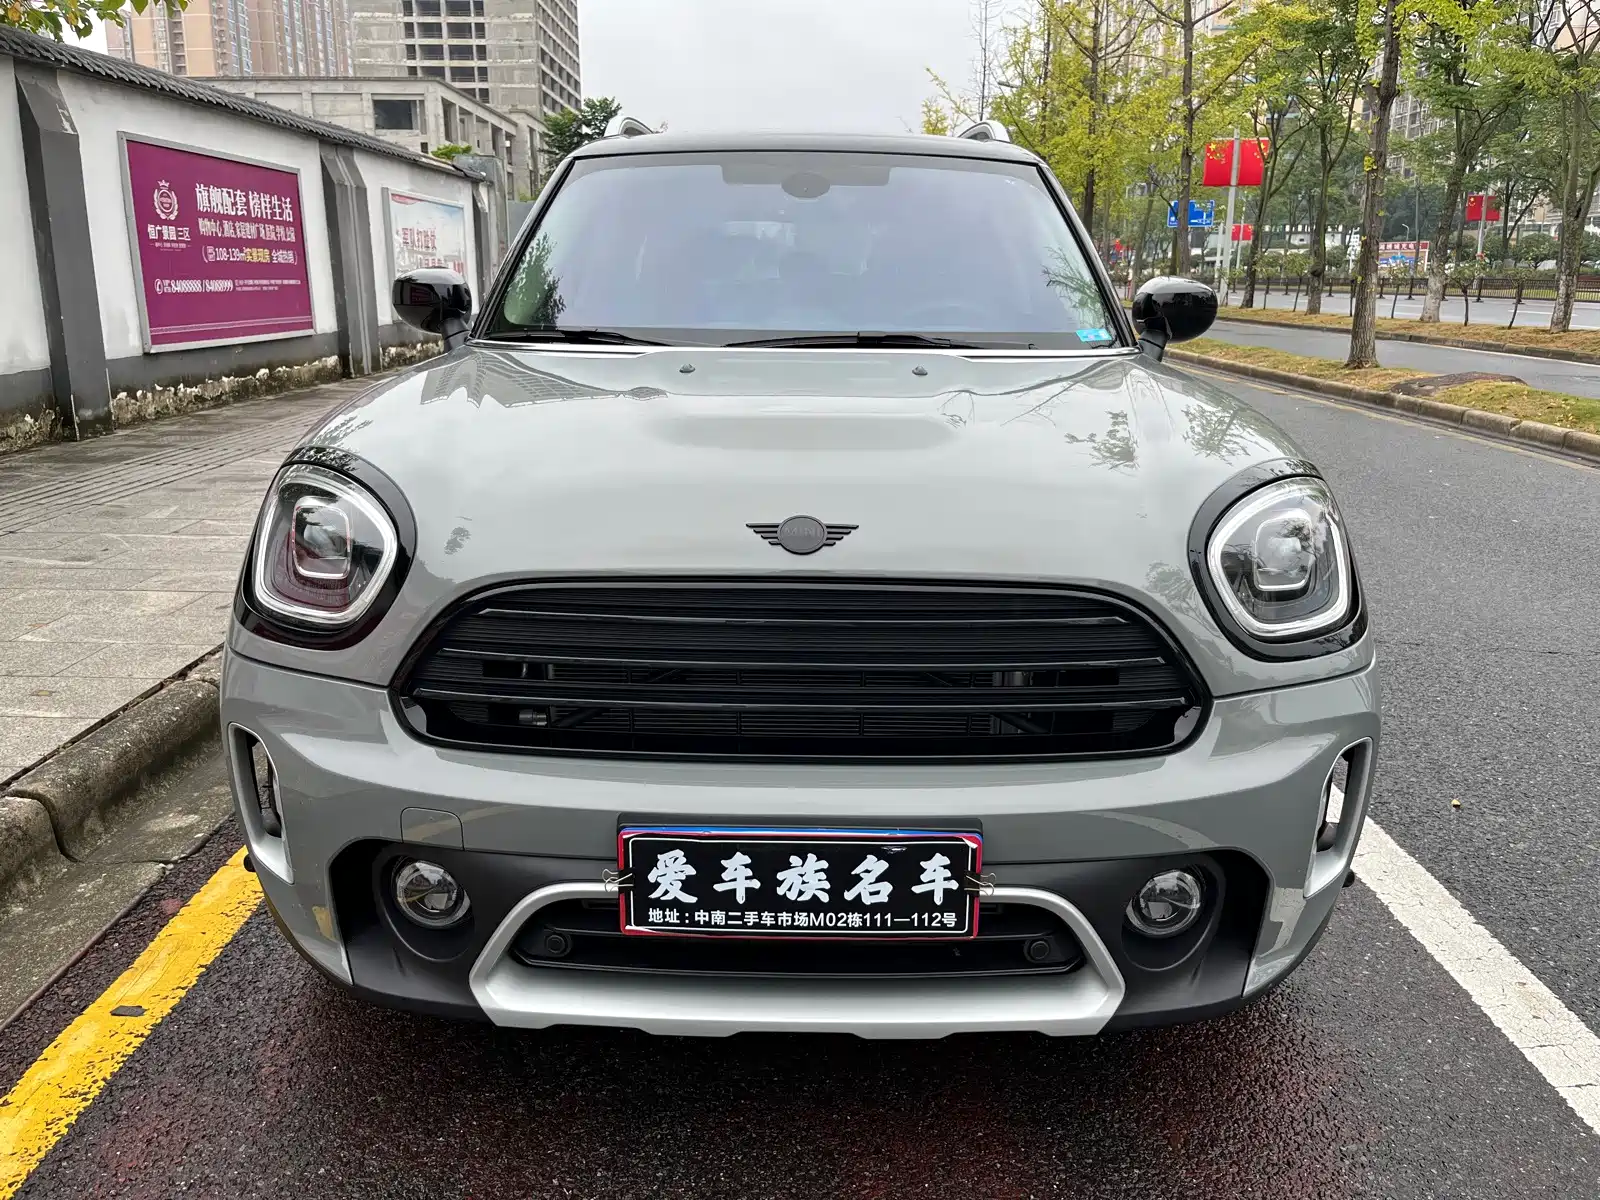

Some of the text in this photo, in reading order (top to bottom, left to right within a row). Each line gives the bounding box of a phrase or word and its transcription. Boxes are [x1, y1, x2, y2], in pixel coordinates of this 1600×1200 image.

[195, 183, 247, 217] 旗舰配套
[248, 191, 293, 222] 榜样生活
[783, 526, 822, 538] MINI
[647, 848, 959, 905] 爱车族名车
